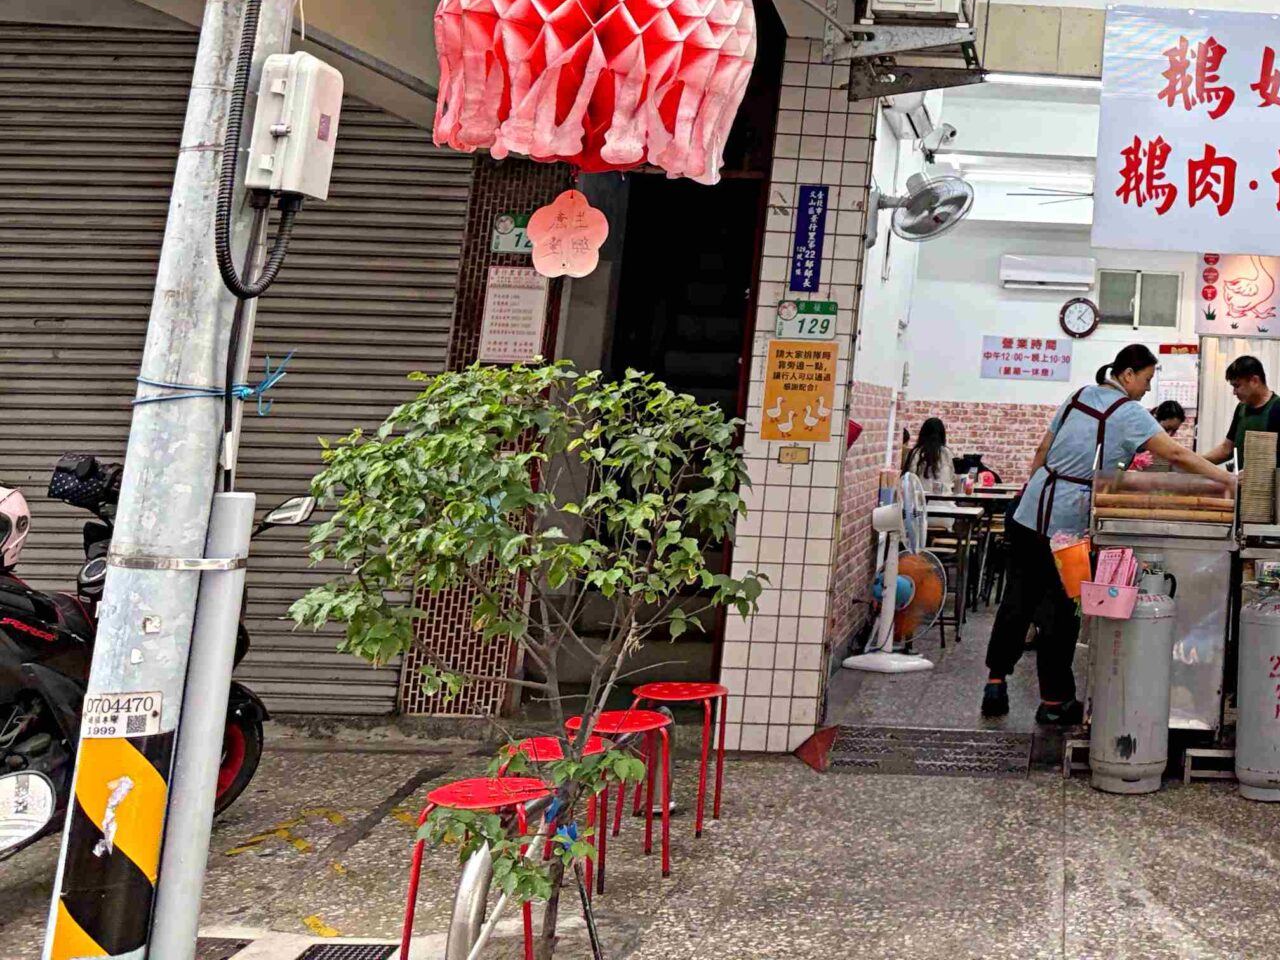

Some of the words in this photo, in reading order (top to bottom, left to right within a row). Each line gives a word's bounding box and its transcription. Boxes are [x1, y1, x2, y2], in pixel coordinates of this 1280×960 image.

[797, 318, 830, 335] 129
[87, 696, 154, 713] 0704470
[87, 726, 116, 735] 1999
